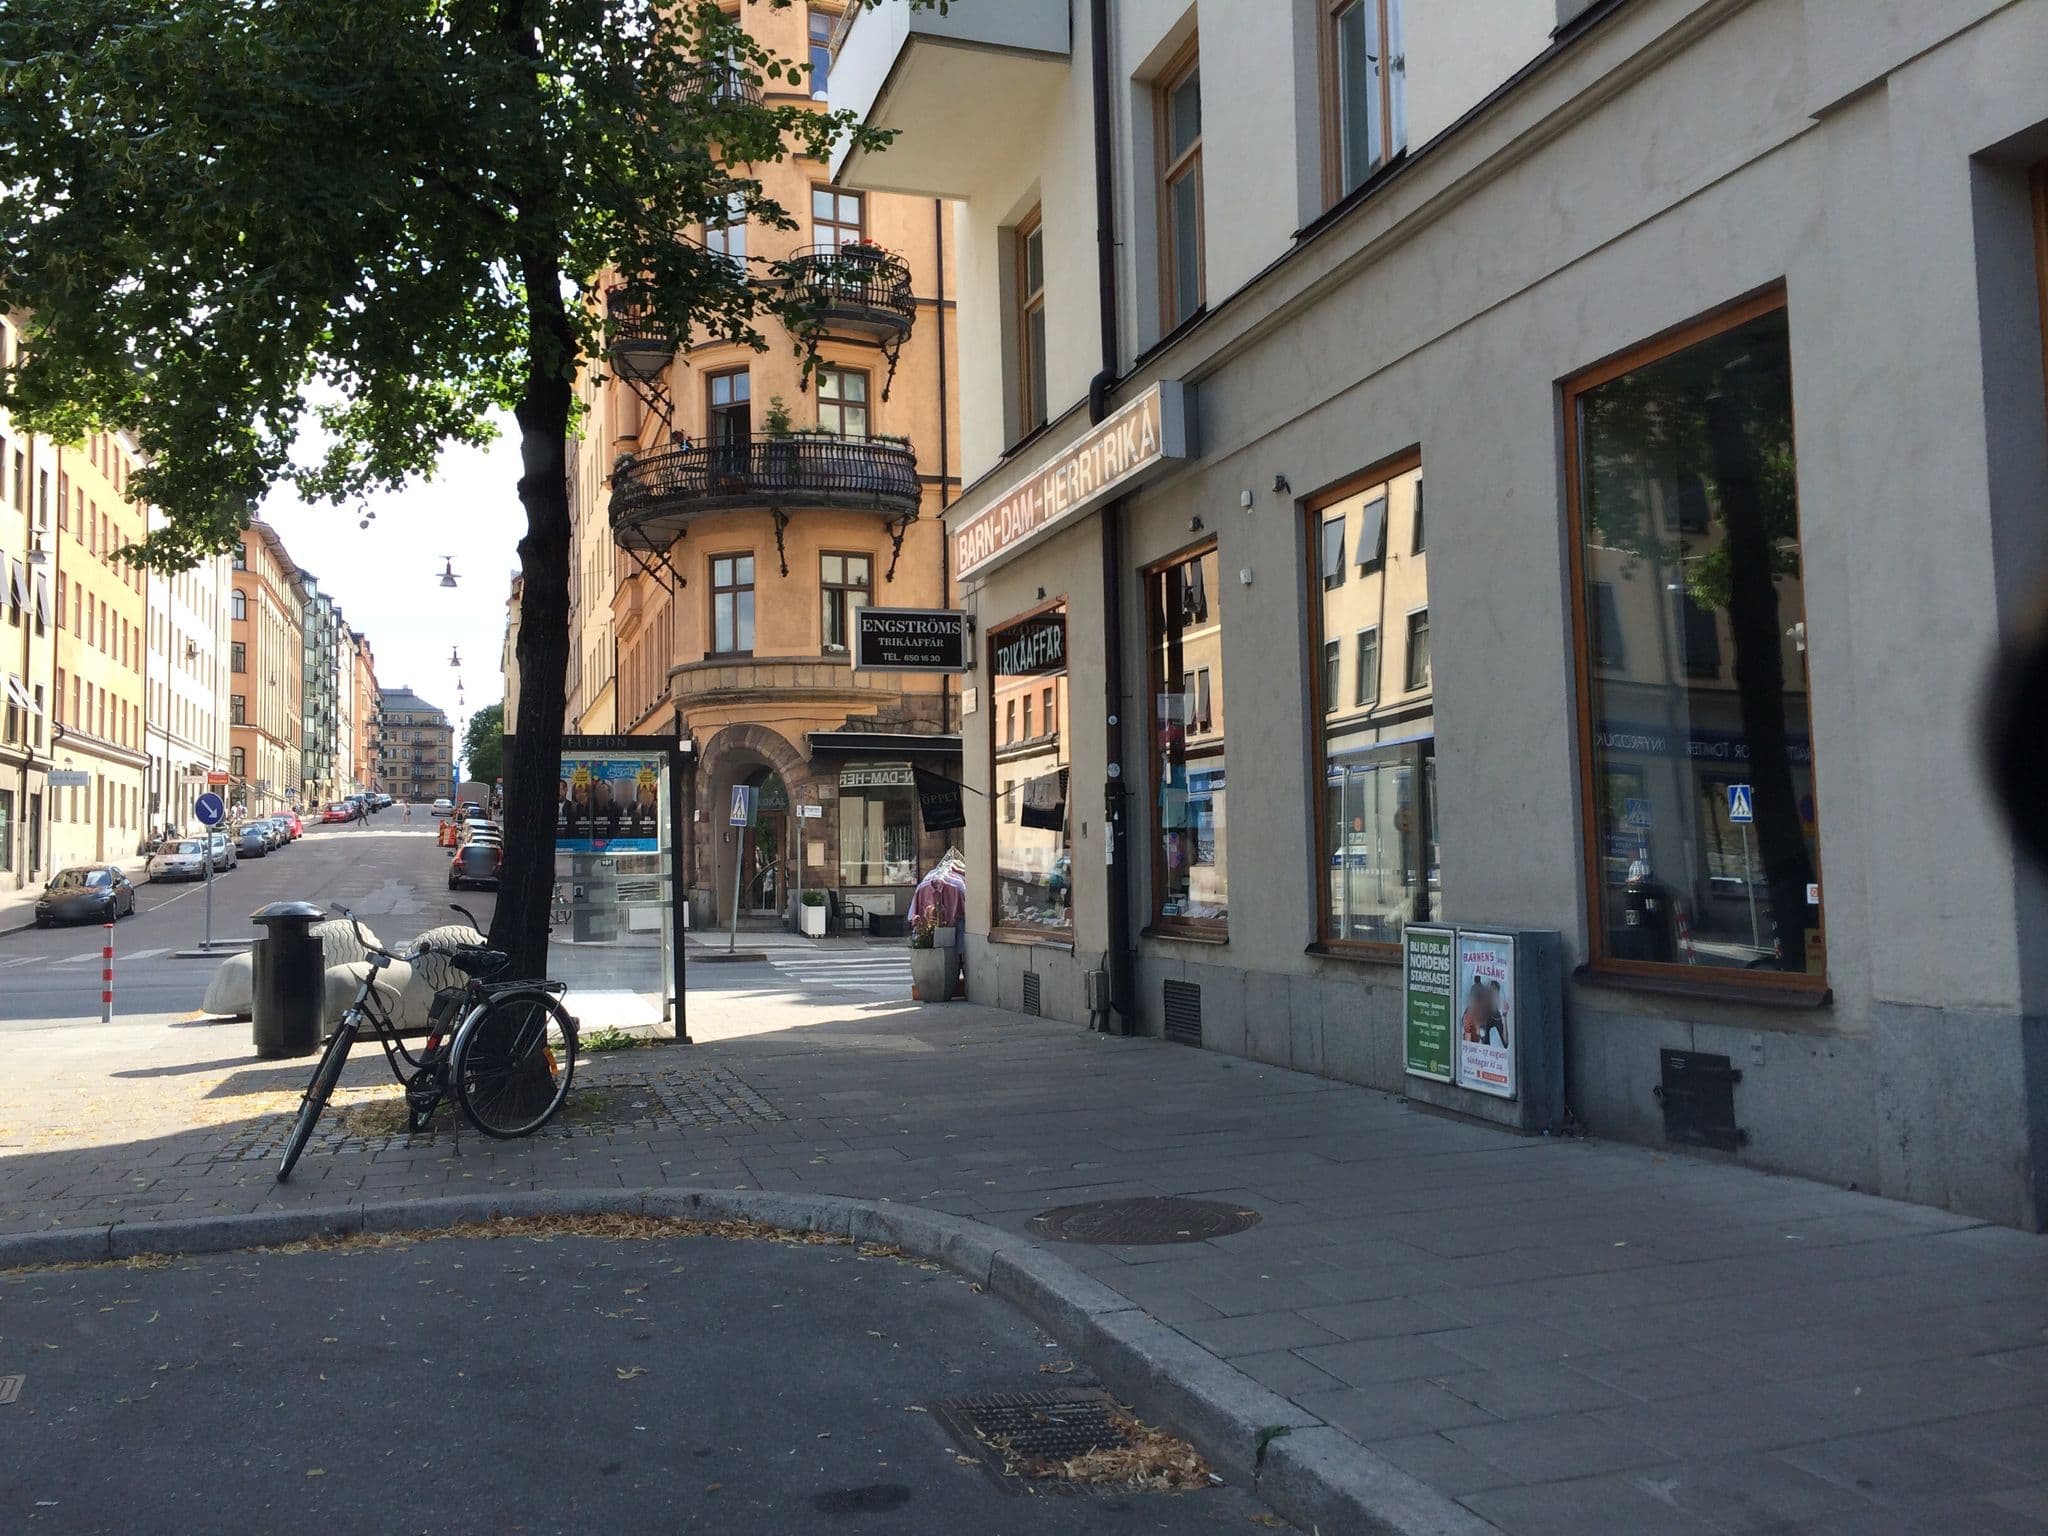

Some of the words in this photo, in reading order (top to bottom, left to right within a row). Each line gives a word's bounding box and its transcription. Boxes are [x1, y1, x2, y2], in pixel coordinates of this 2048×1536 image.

[959, 400, 1156, 572] BARN-DAM-HERRTRIKÅ
[862, 618, 961, 634] ENGSTRÖMS
[878, 636, 944, 647] TRIKÅAFFÄR
[997, 625, 1062, 676] TRIKÅAFFÄR
[921, 791, 959, 805] ÖPPET
[1420, 942, 1429, 953] EN
[1429, 943, 1440, 954] DEL
[1441, 944, 1450, 955] AV
[1410, 953, 1450, 972] NORDENS
[1463, 951, 1495, 963] BARNENS
[1410, 970, 1450, 986] STARKASTE
[1475, 964, 1505, 980] ALLSÅNG
